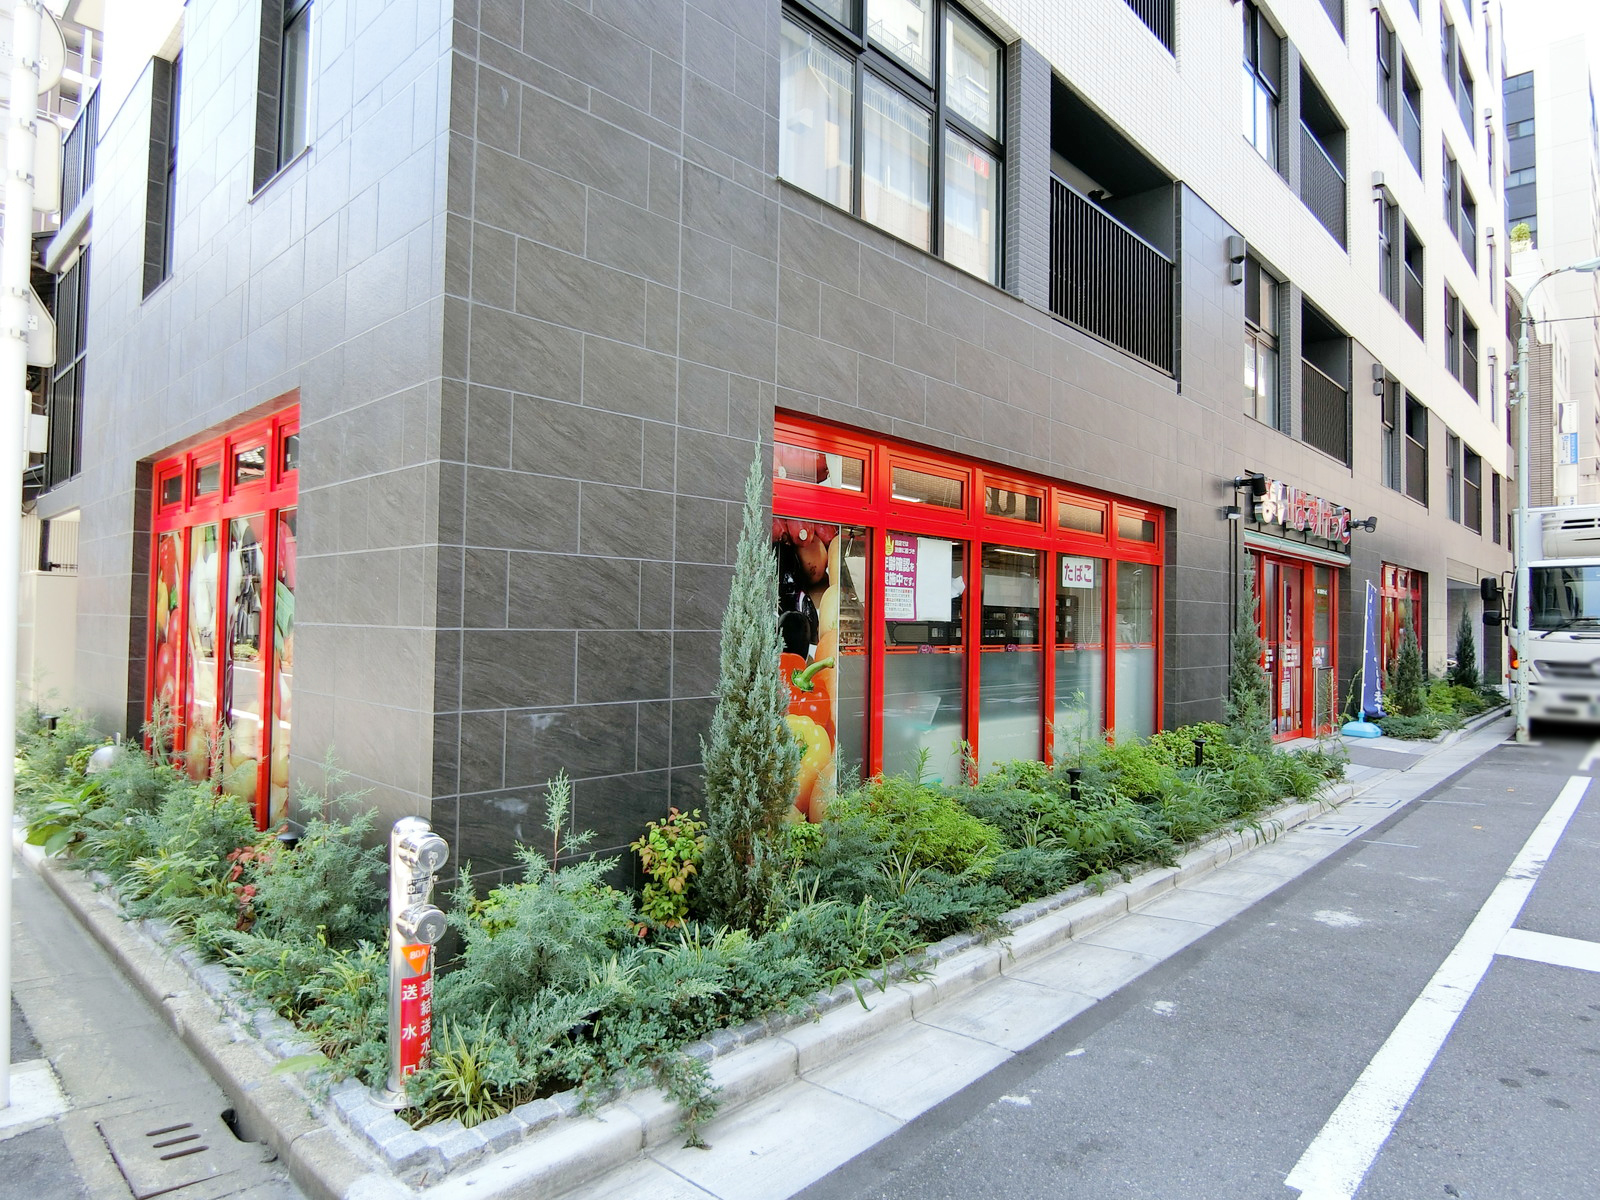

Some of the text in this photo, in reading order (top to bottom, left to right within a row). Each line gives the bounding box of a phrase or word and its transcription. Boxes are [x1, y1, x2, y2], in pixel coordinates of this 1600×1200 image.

[1064, 563, 1092, 582] たばこ
[409, 949, 427, 960] 80A
[402, 984, 418, 1077] 送水口
